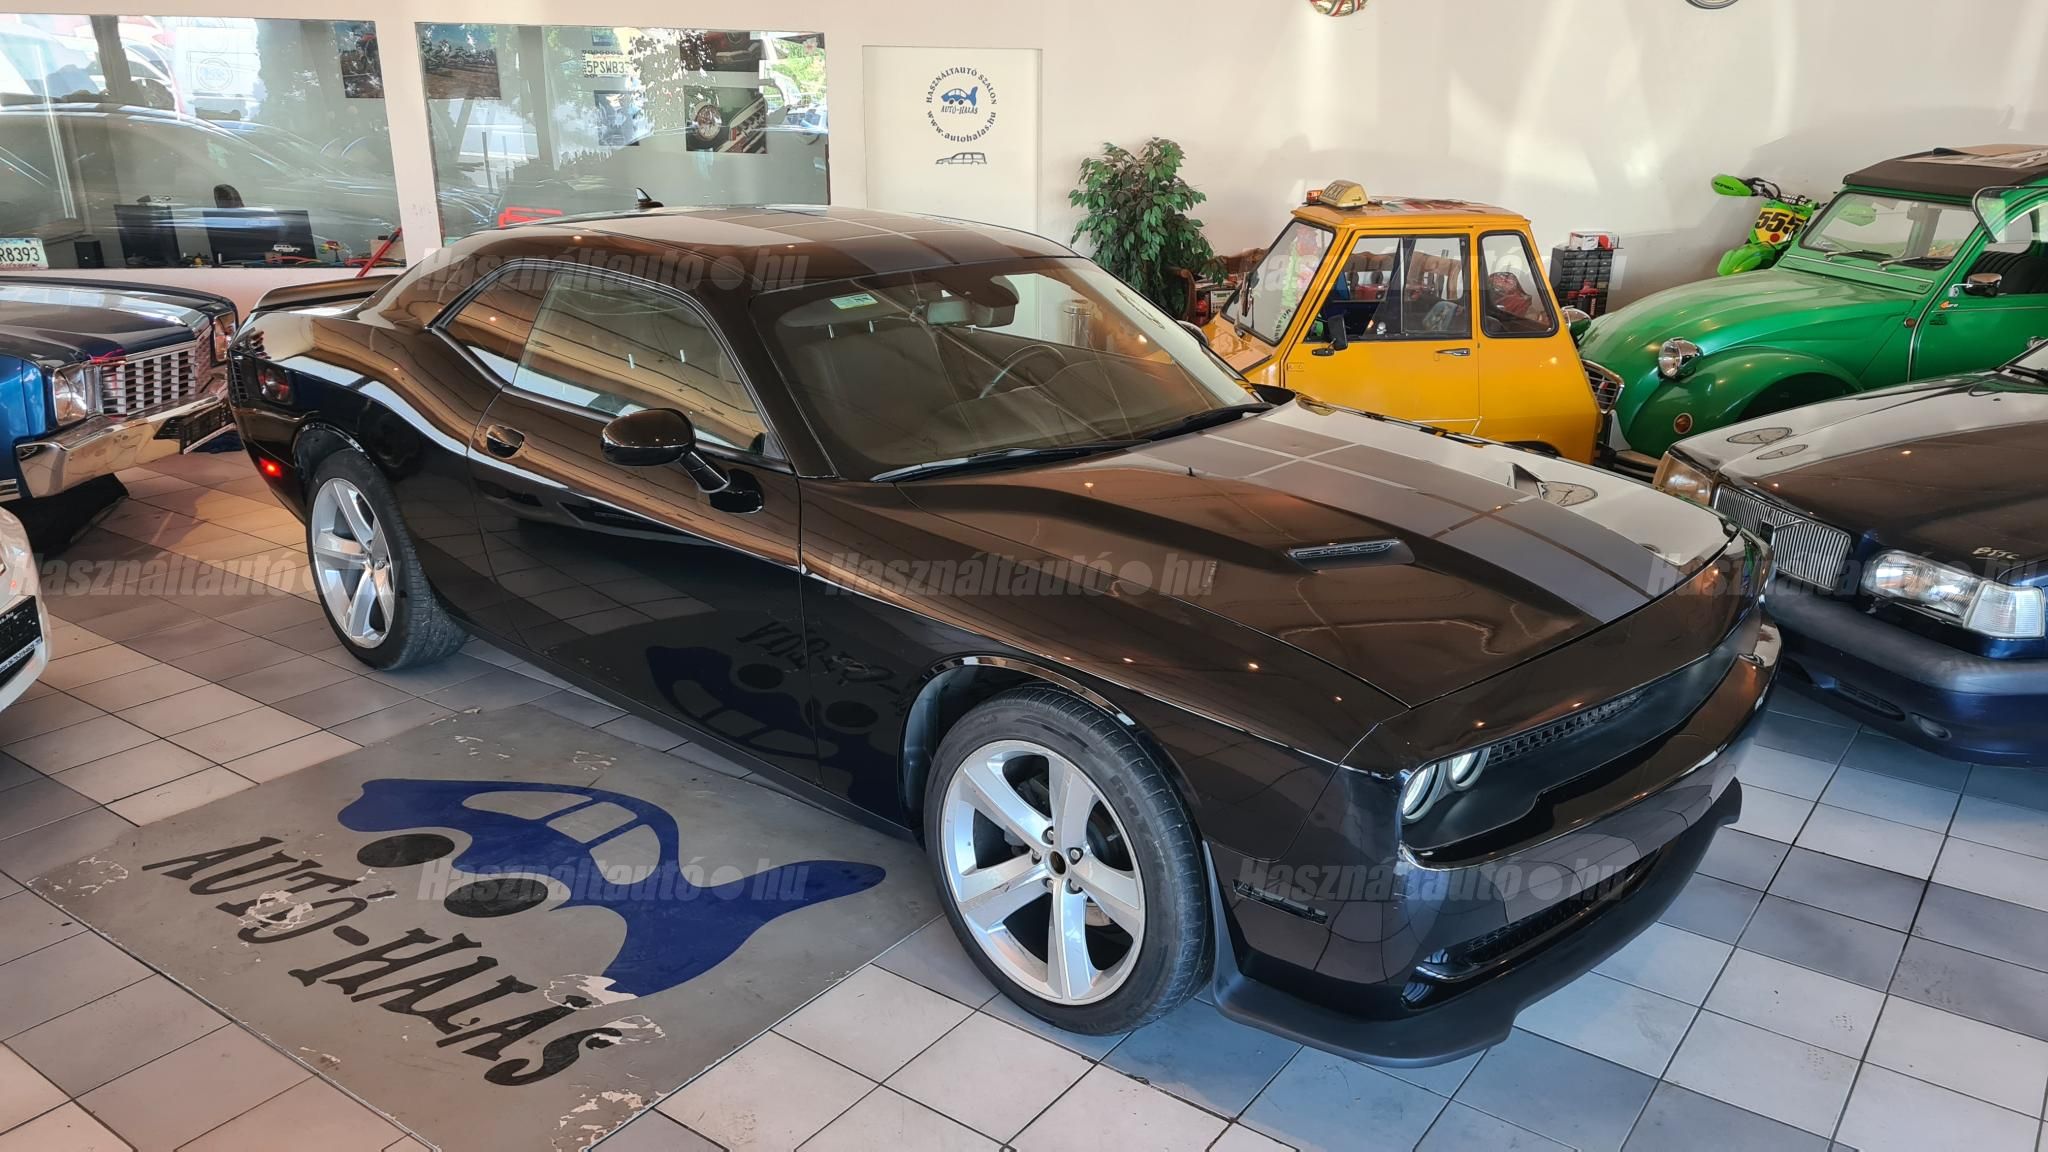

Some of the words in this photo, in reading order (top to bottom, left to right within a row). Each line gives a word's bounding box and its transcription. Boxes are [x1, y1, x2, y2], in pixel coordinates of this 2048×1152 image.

[926, 66, 978, 103] HASZNÁLTAUTÓ
[977, 74, 998, 105] SZALON
[927, 110, 997, 143] www.autohalas.hu
[1755, 211, 1805, 234] 555
